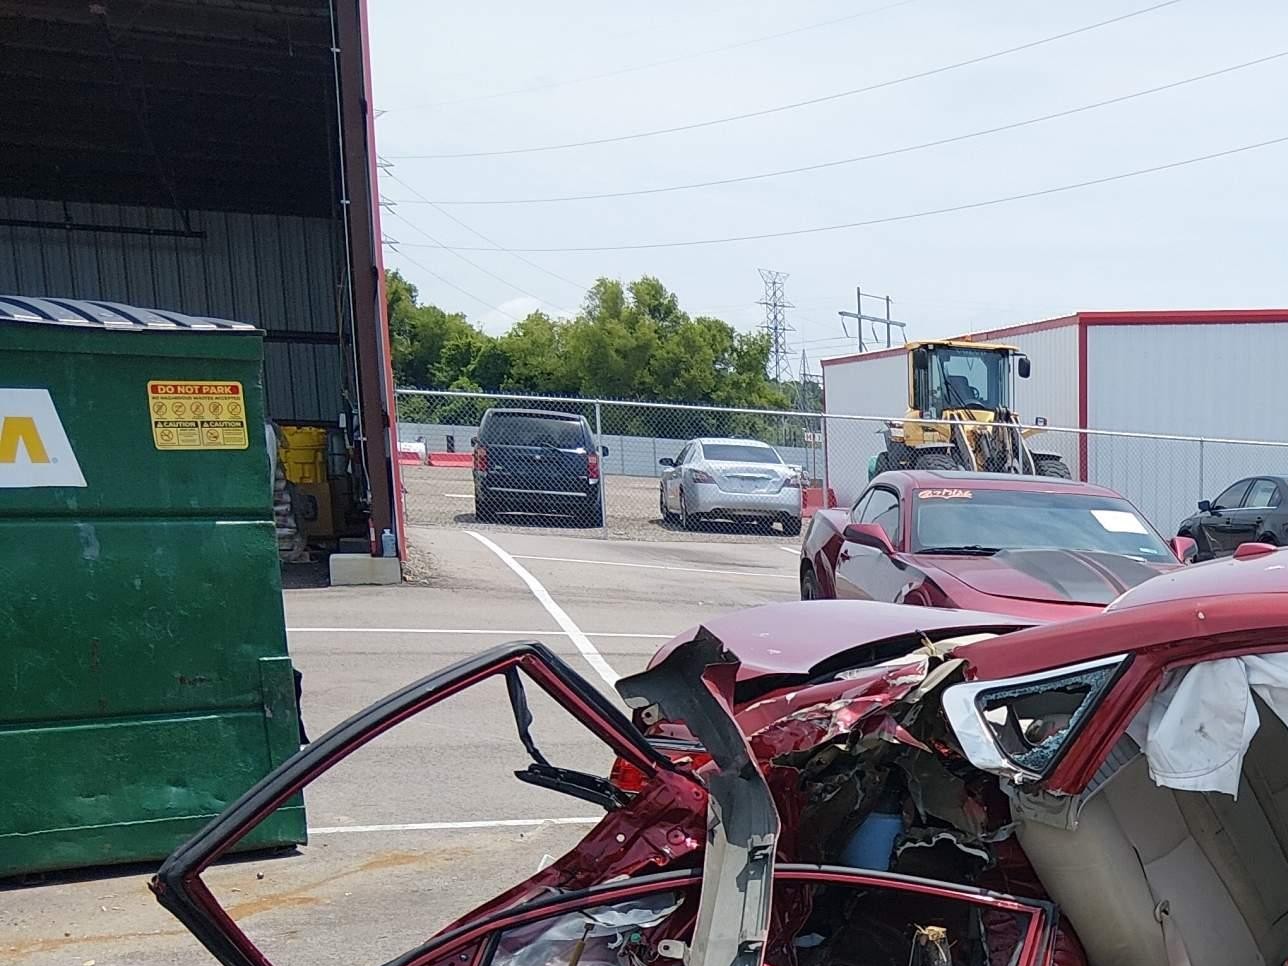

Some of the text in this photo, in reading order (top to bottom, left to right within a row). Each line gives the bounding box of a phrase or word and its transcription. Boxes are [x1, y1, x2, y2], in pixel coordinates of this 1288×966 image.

[157, 385, 232, 394] DO NOT PARK
